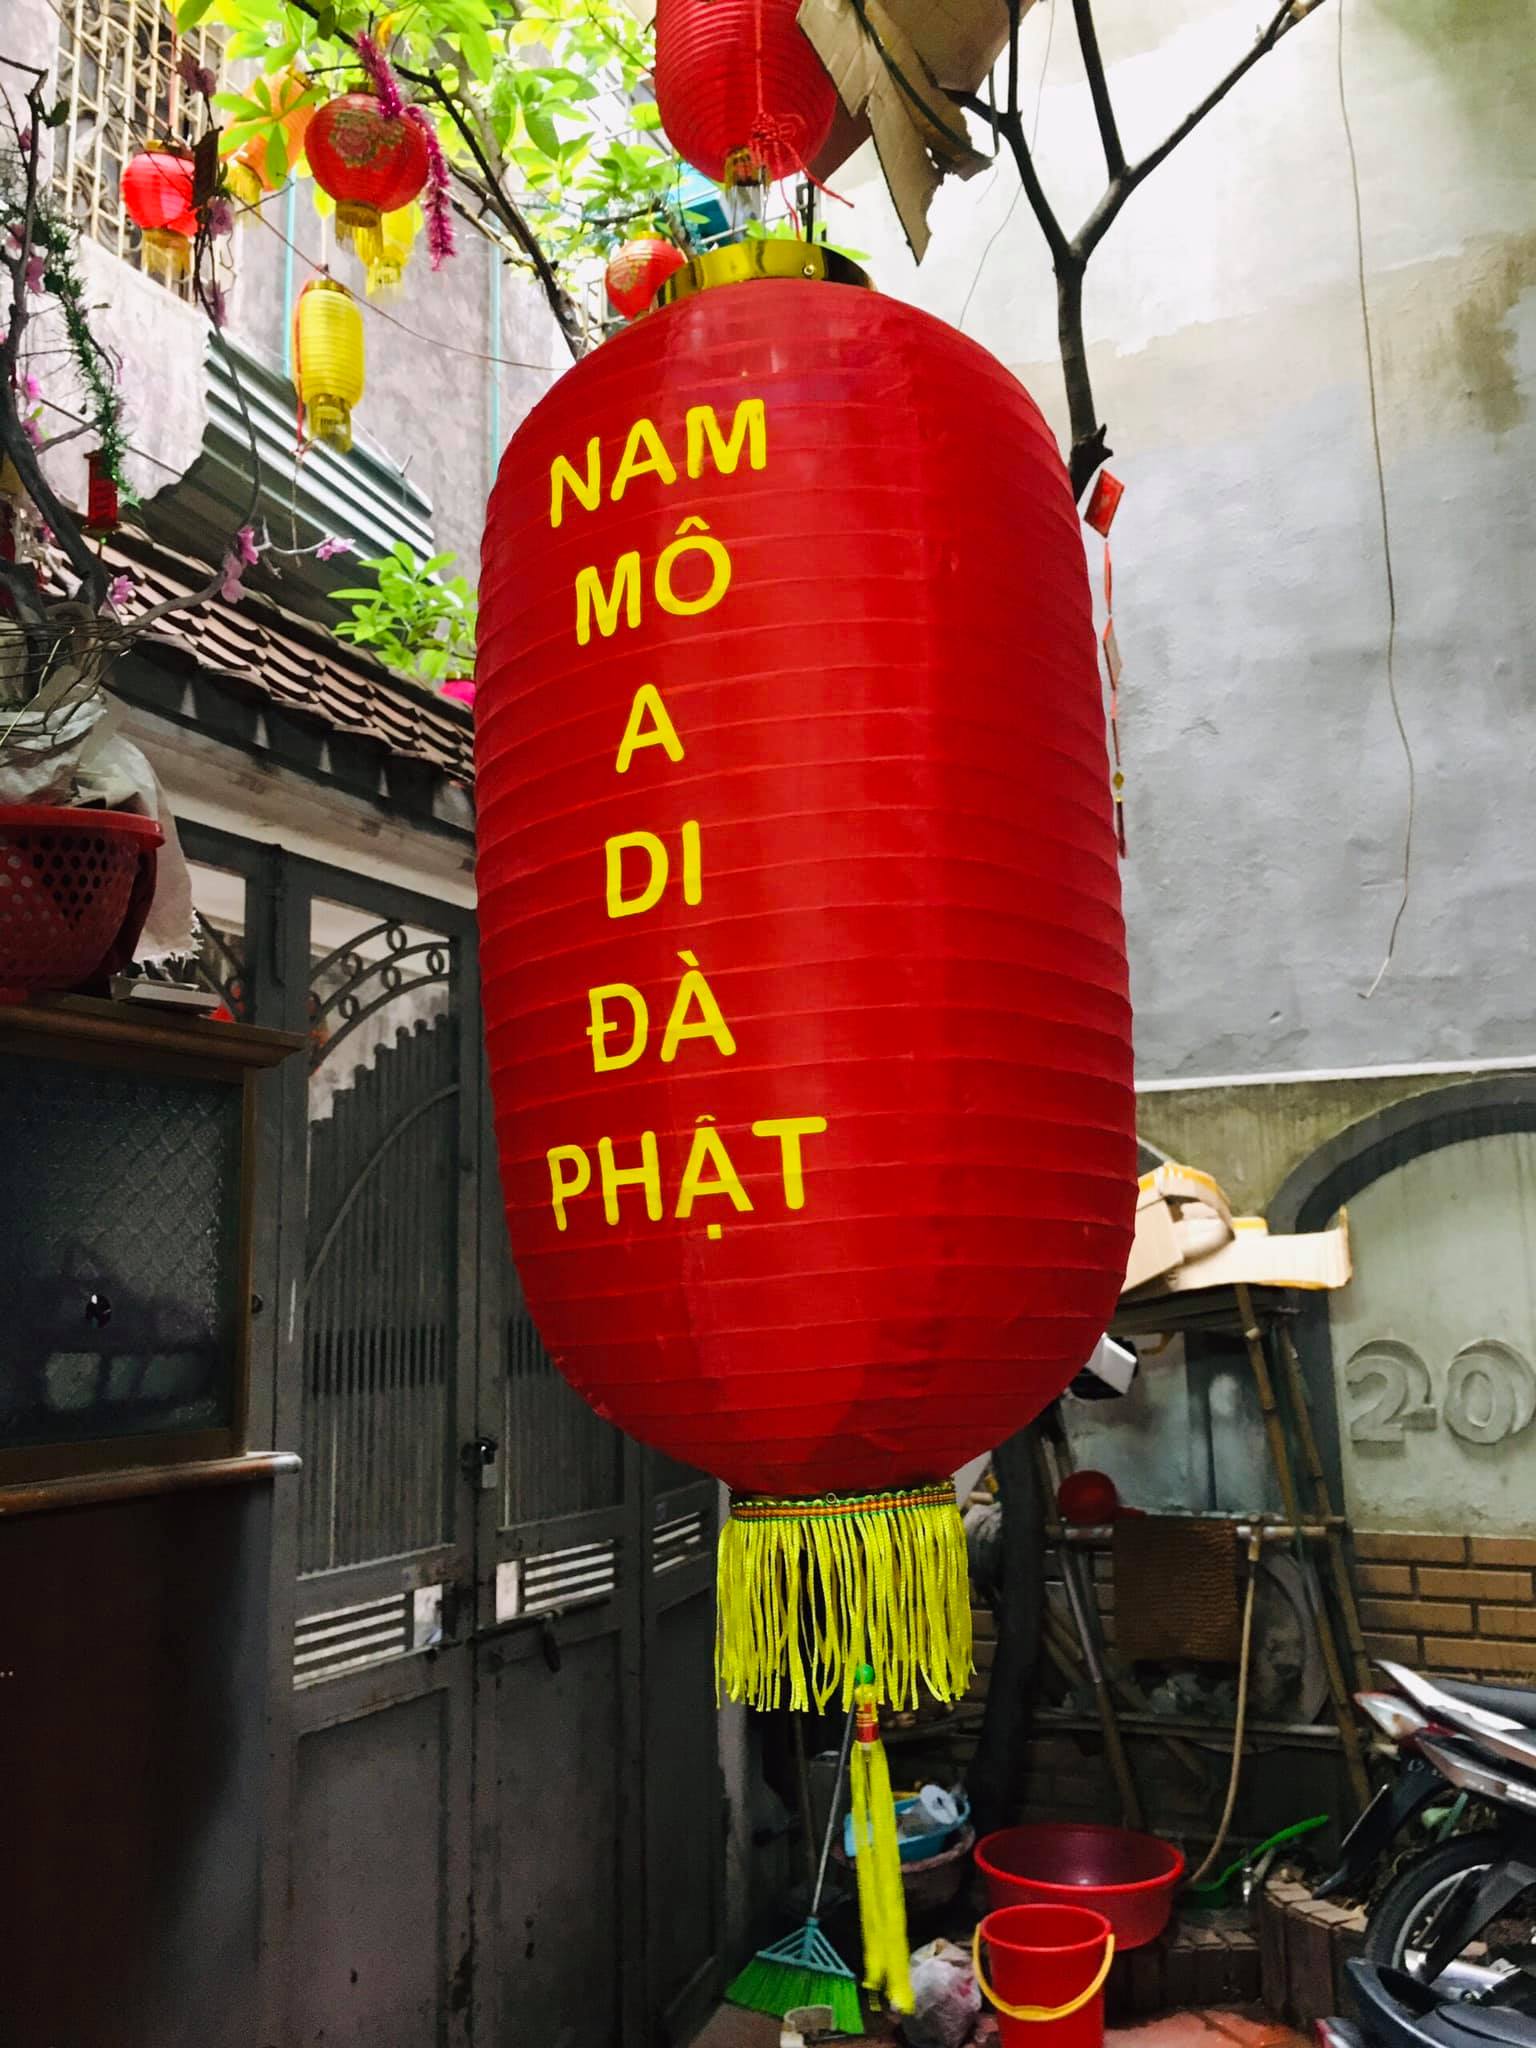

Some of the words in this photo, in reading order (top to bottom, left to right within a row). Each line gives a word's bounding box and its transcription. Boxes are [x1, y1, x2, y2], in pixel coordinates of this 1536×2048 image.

[551, 399, 767, 528] NAM
[575, 516, 731, 645] MÔ
[616, 683, 684, 773] A
[605, 820, 702, 918] DI
[586, 950, 737, 1073] ĐÀ
[547, 1115, 827, 1240] PHẬT
